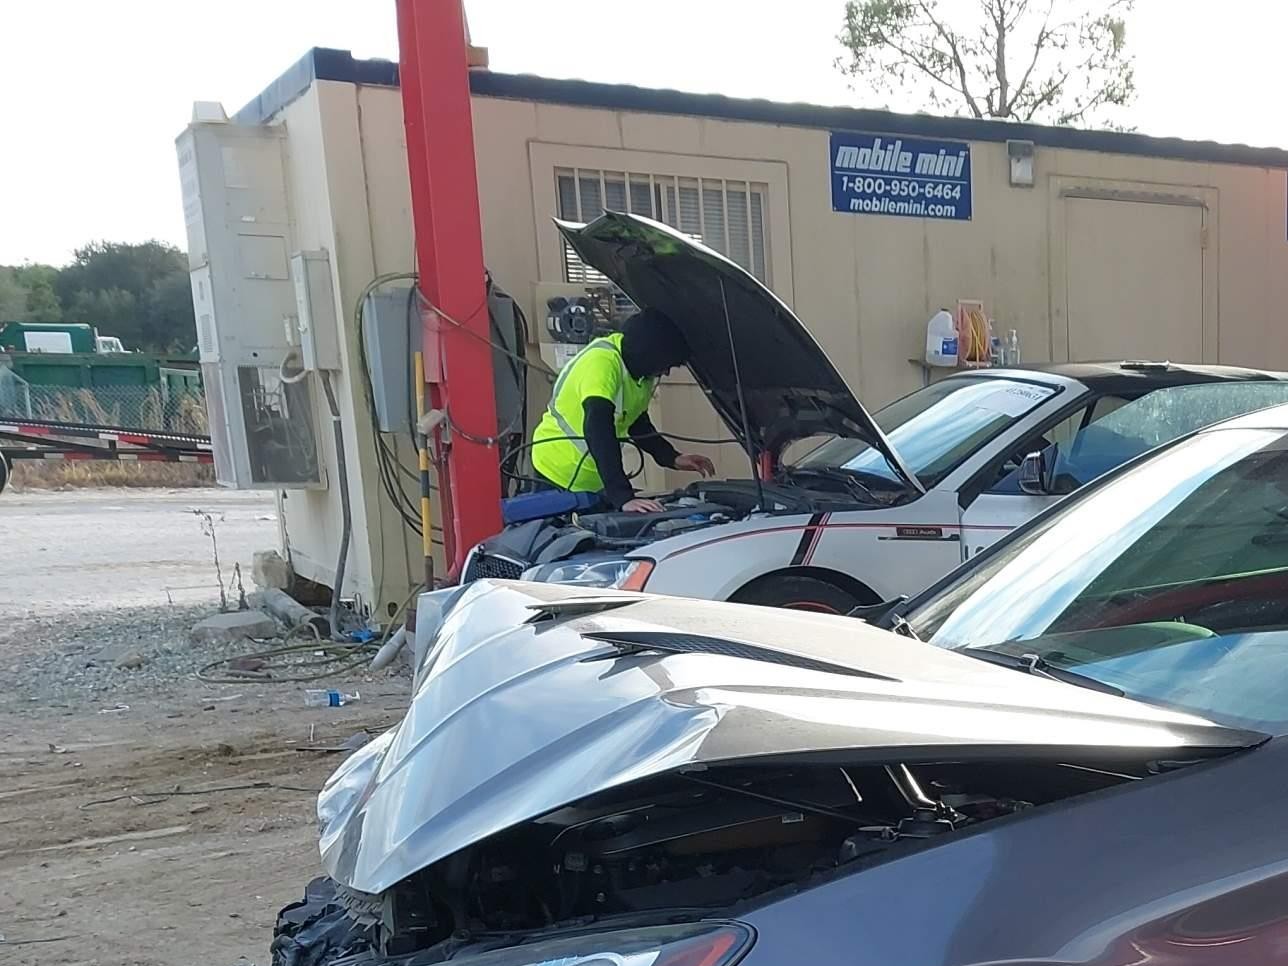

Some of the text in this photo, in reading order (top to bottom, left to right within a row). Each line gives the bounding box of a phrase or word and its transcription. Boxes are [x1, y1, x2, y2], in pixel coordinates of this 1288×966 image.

[835, 138, 966, 177] mobile mini
[842, 176, 961, 200] 1-800-950-6464
[850, 196, 956, 217] mobilemini.com
